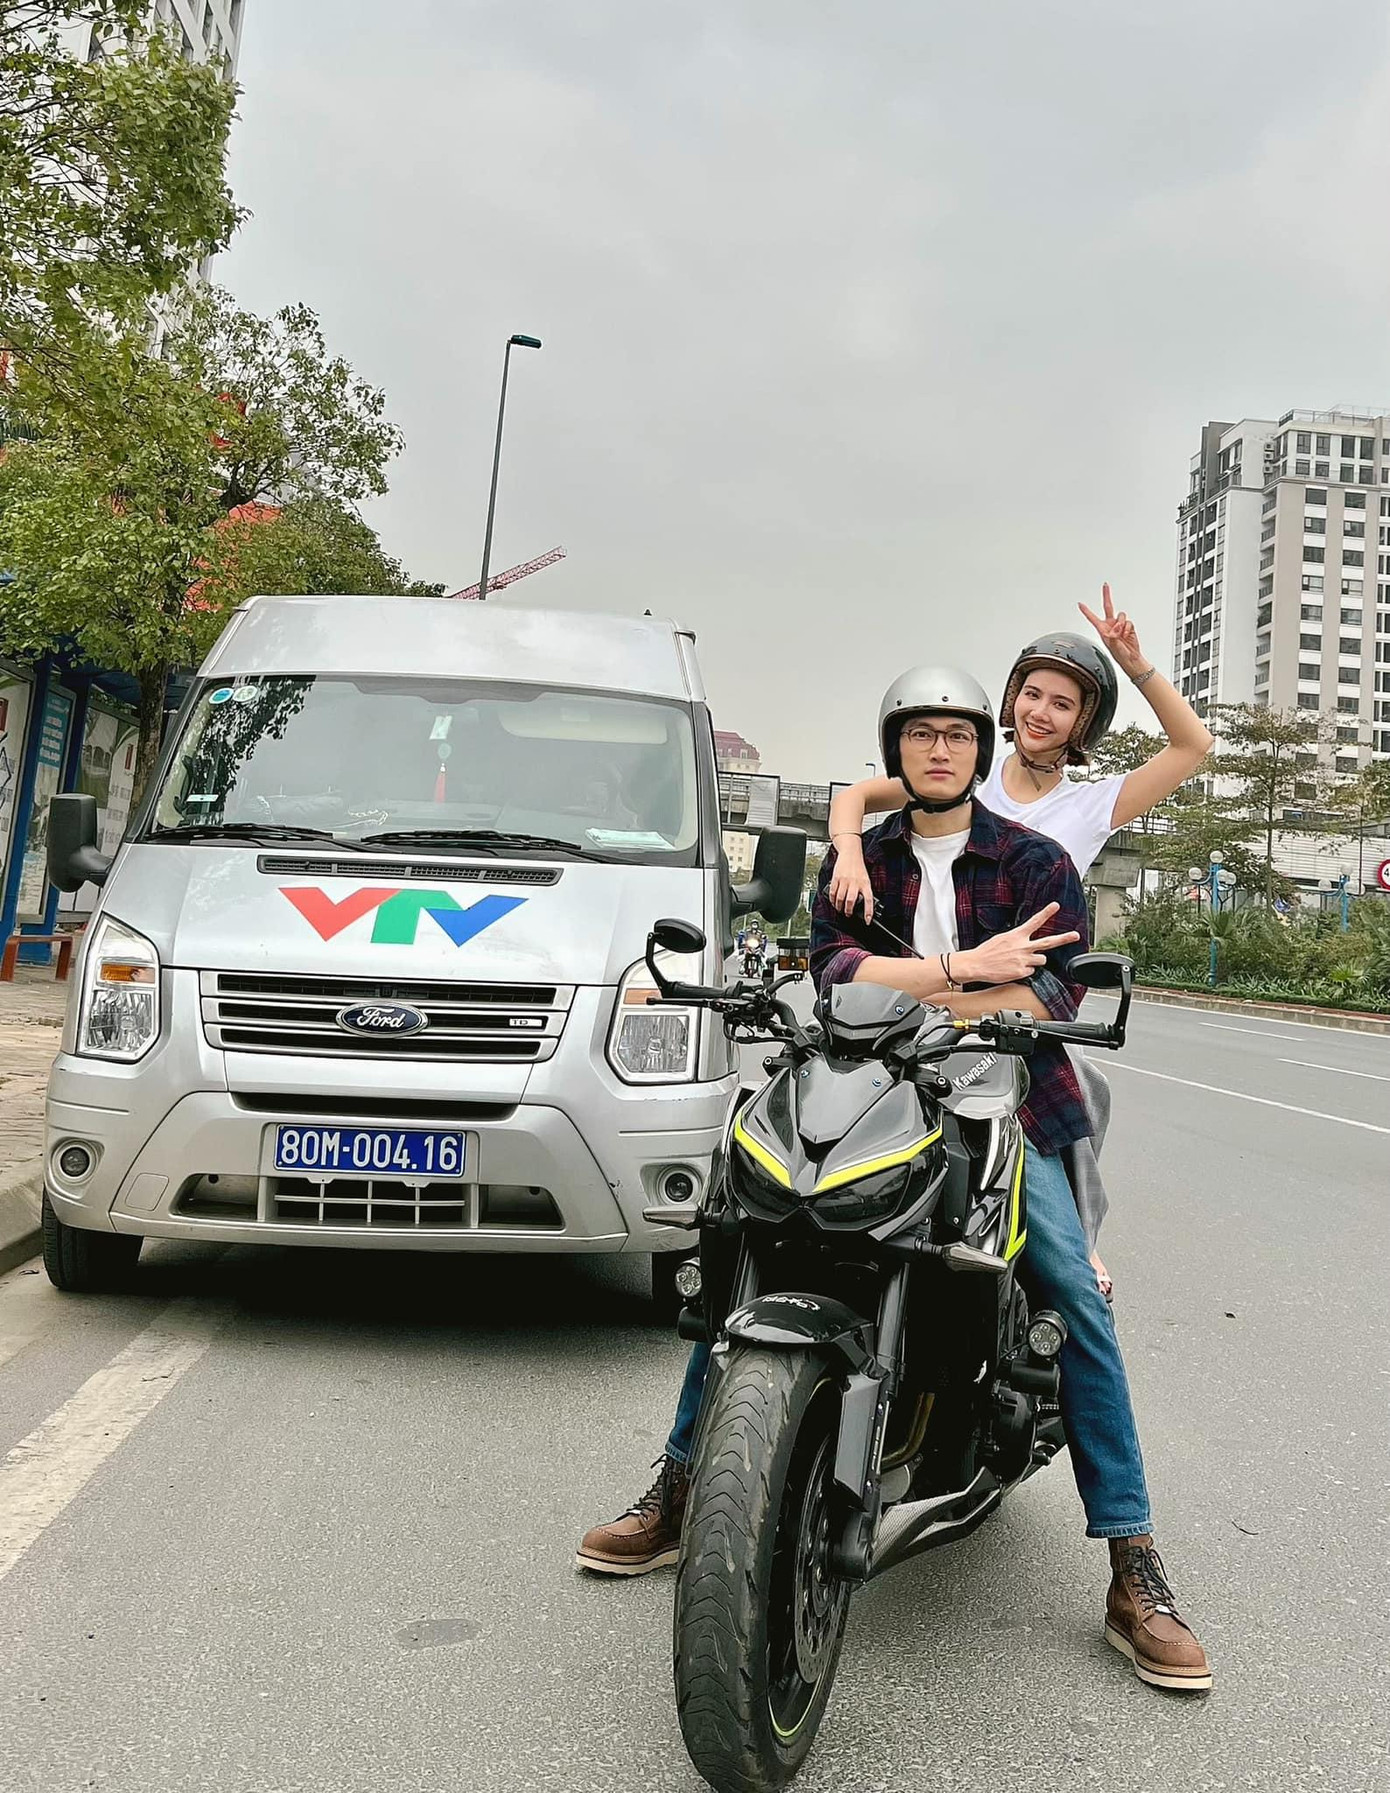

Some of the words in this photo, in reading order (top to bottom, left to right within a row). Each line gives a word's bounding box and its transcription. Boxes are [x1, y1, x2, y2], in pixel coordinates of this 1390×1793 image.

[278, 887, 529, 947] VTV
[356, 1006, 406, 1028] Ford
[952, 1051, 997, 1091] Kawasaki
[281, 1129, 458, 1171] 80M-004.16
